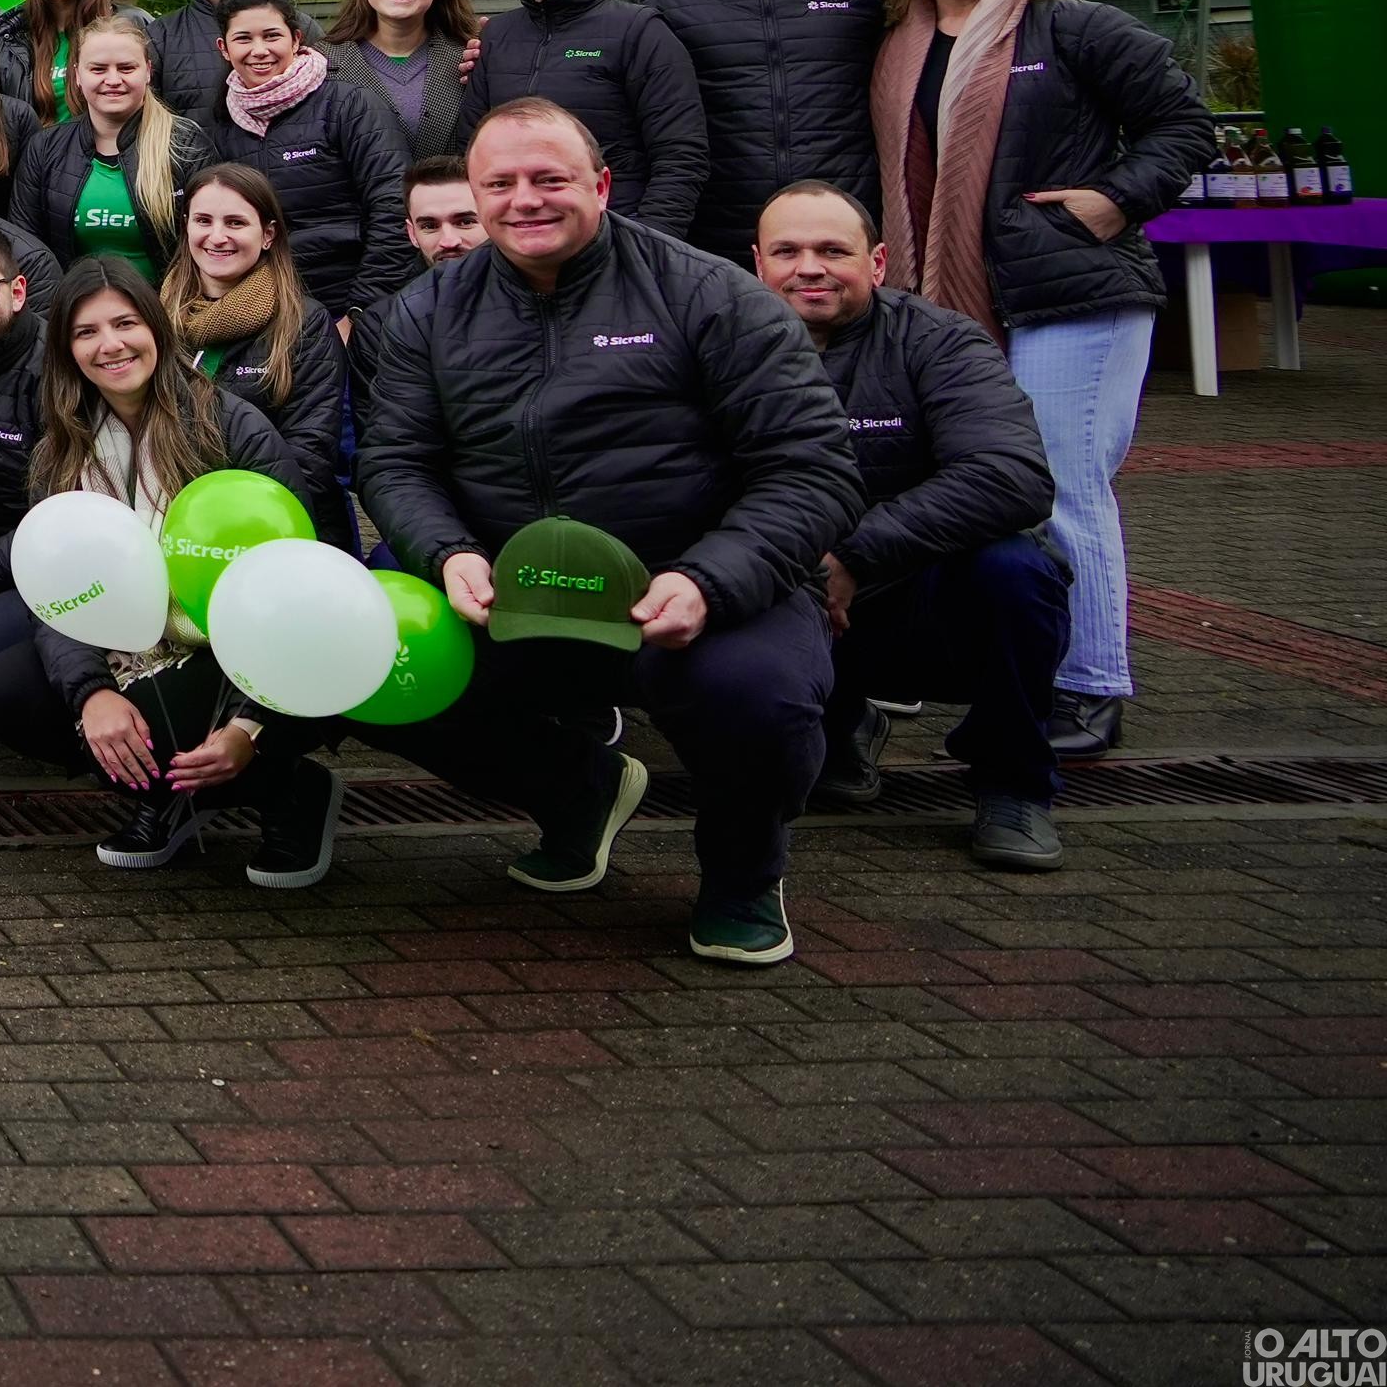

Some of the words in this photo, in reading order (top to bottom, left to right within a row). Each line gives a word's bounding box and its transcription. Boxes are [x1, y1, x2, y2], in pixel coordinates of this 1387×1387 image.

[820, 1, 849, 9] Sicredi
[85, 208, 136, 227] Sicr
[609, 333, 655, 347] Sicredi
[862, 417, 902, 429] Sicredi
[539, 570, 605, 593] Sicredi
[49, 580, 105, 616] Sicredi
